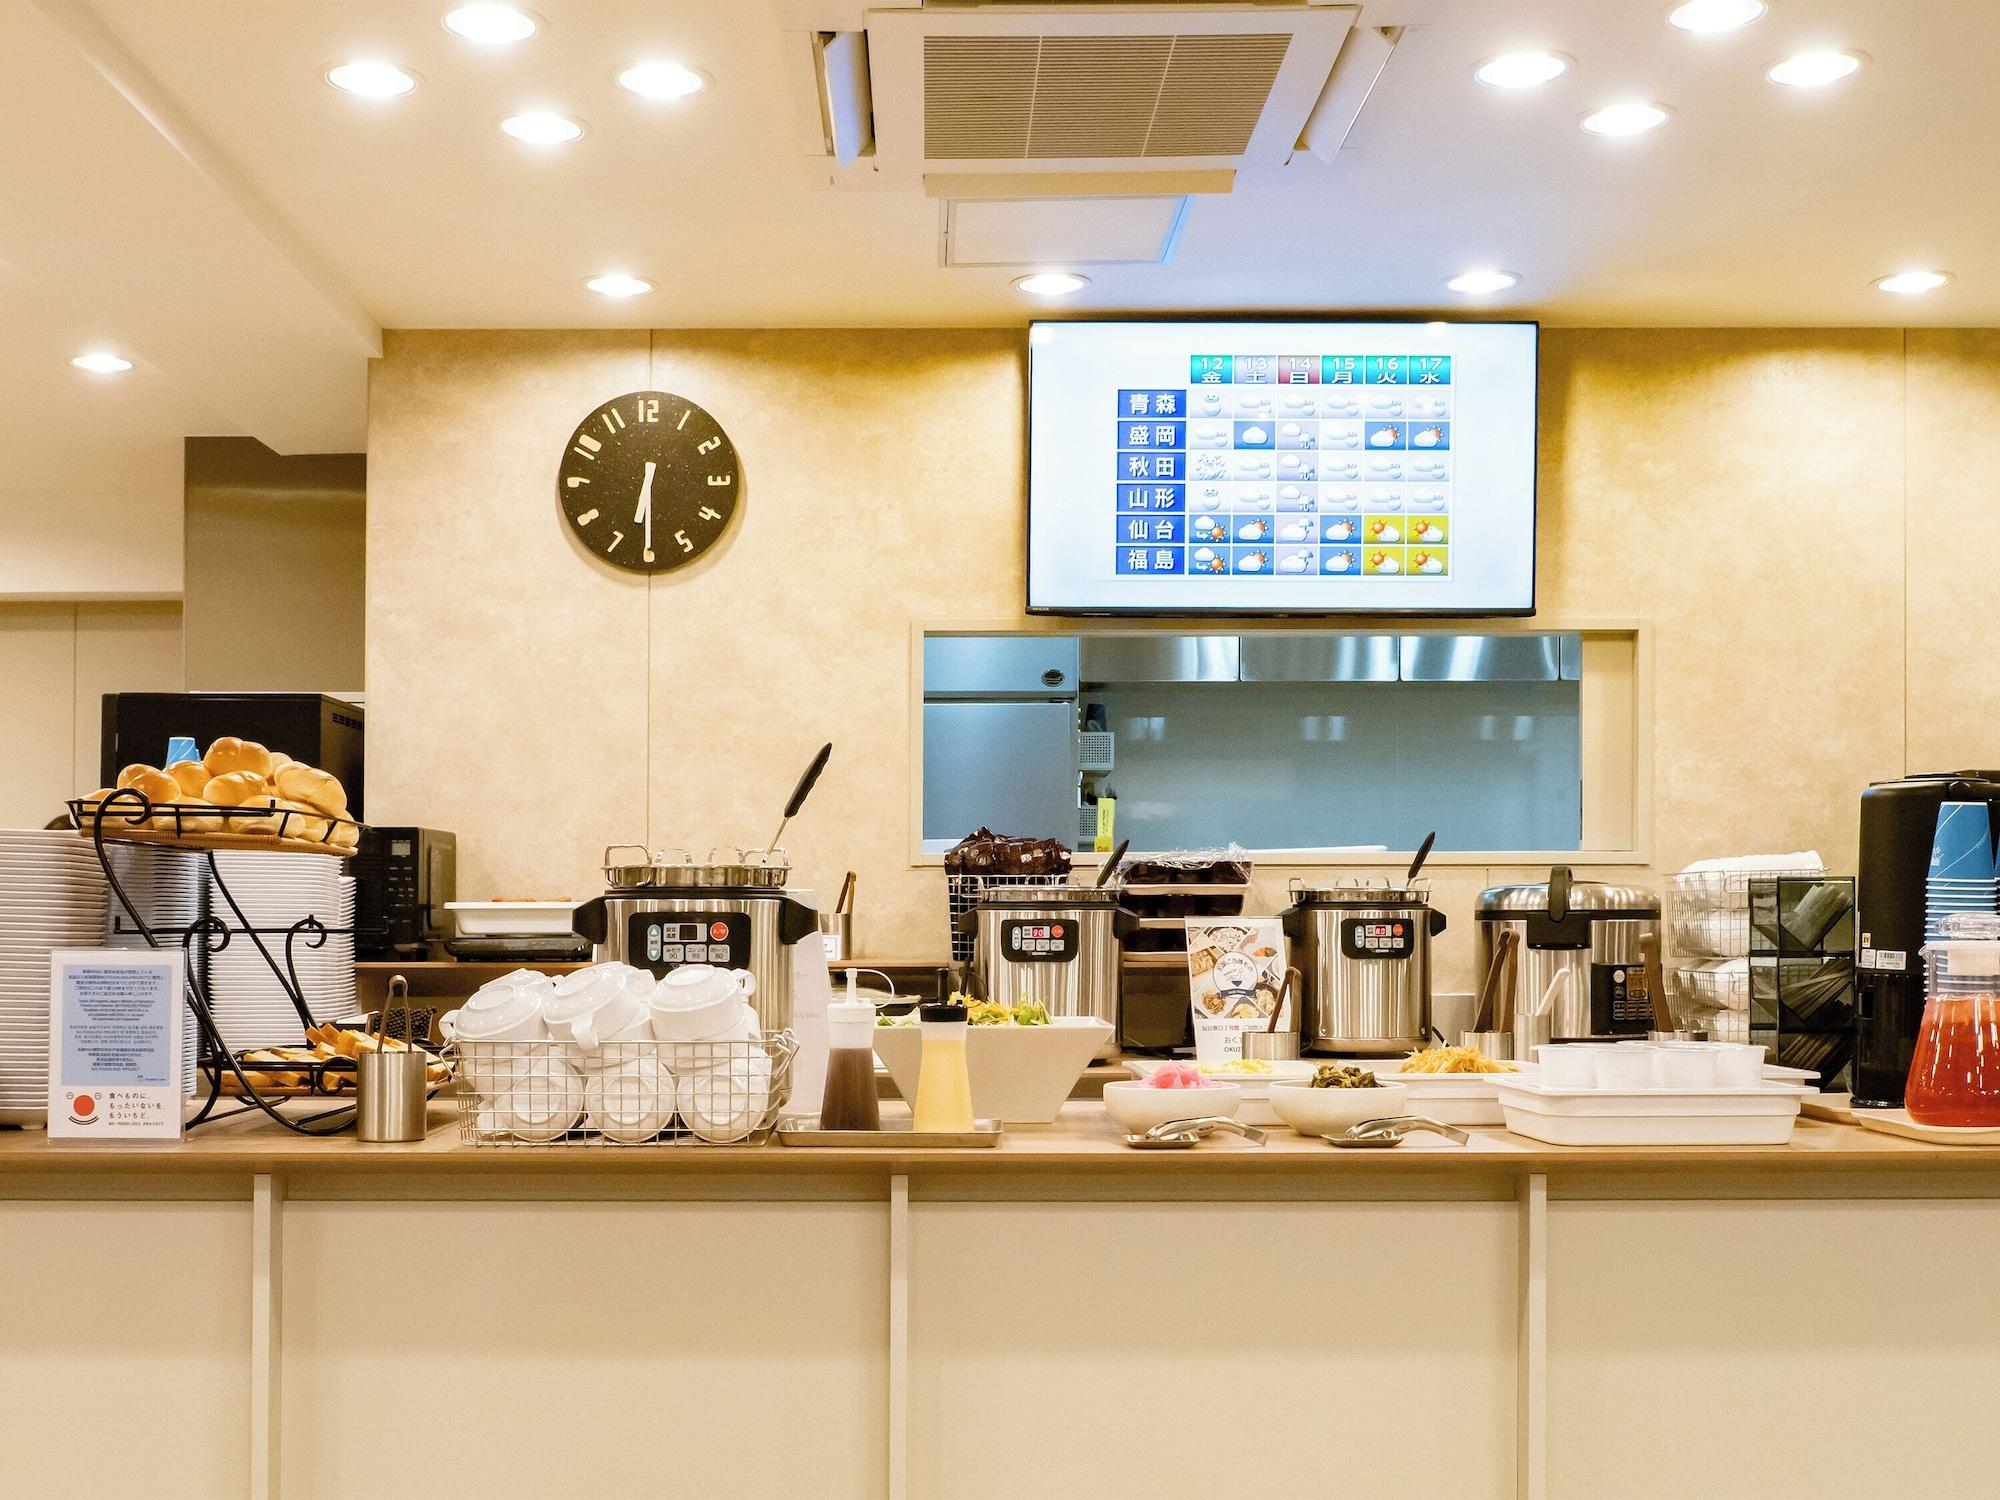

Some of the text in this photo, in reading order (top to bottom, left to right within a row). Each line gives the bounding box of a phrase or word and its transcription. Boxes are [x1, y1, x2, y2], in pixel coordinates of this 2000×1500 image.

[1200, 357, 1443, 370] 12 13 14 15 16 17
[1201, 370, 1441, 384] 金 土 日 月 火 水
[638, 399, 659, 422] 12
[1129, 393, 1176, 415] 青森
[601, 407, 626, 434] 11
[676, 409, 692, 431] 1
[697, 435, 722, 456] 2
[1129, 425, 1176, 446] 盛岡
[573, 434, 602, 461] 10
[1129, 456, 1175, 477] 秋田
[566, 476, 591, 488] 9
[707, 474, 731, 486] 3
[1128, 487, 1175, 509] 山形
[577, 508, 600, 527] 8
[698, 505, 722, 521] 4
[1128, 519, 1174, 540] 仙台
[607, 530, 625, 553] 7
[674, 529, 694, 553] 5
[1128, 549, 1174, 570] 福島
[1032, 928, 1044, 937] 90
